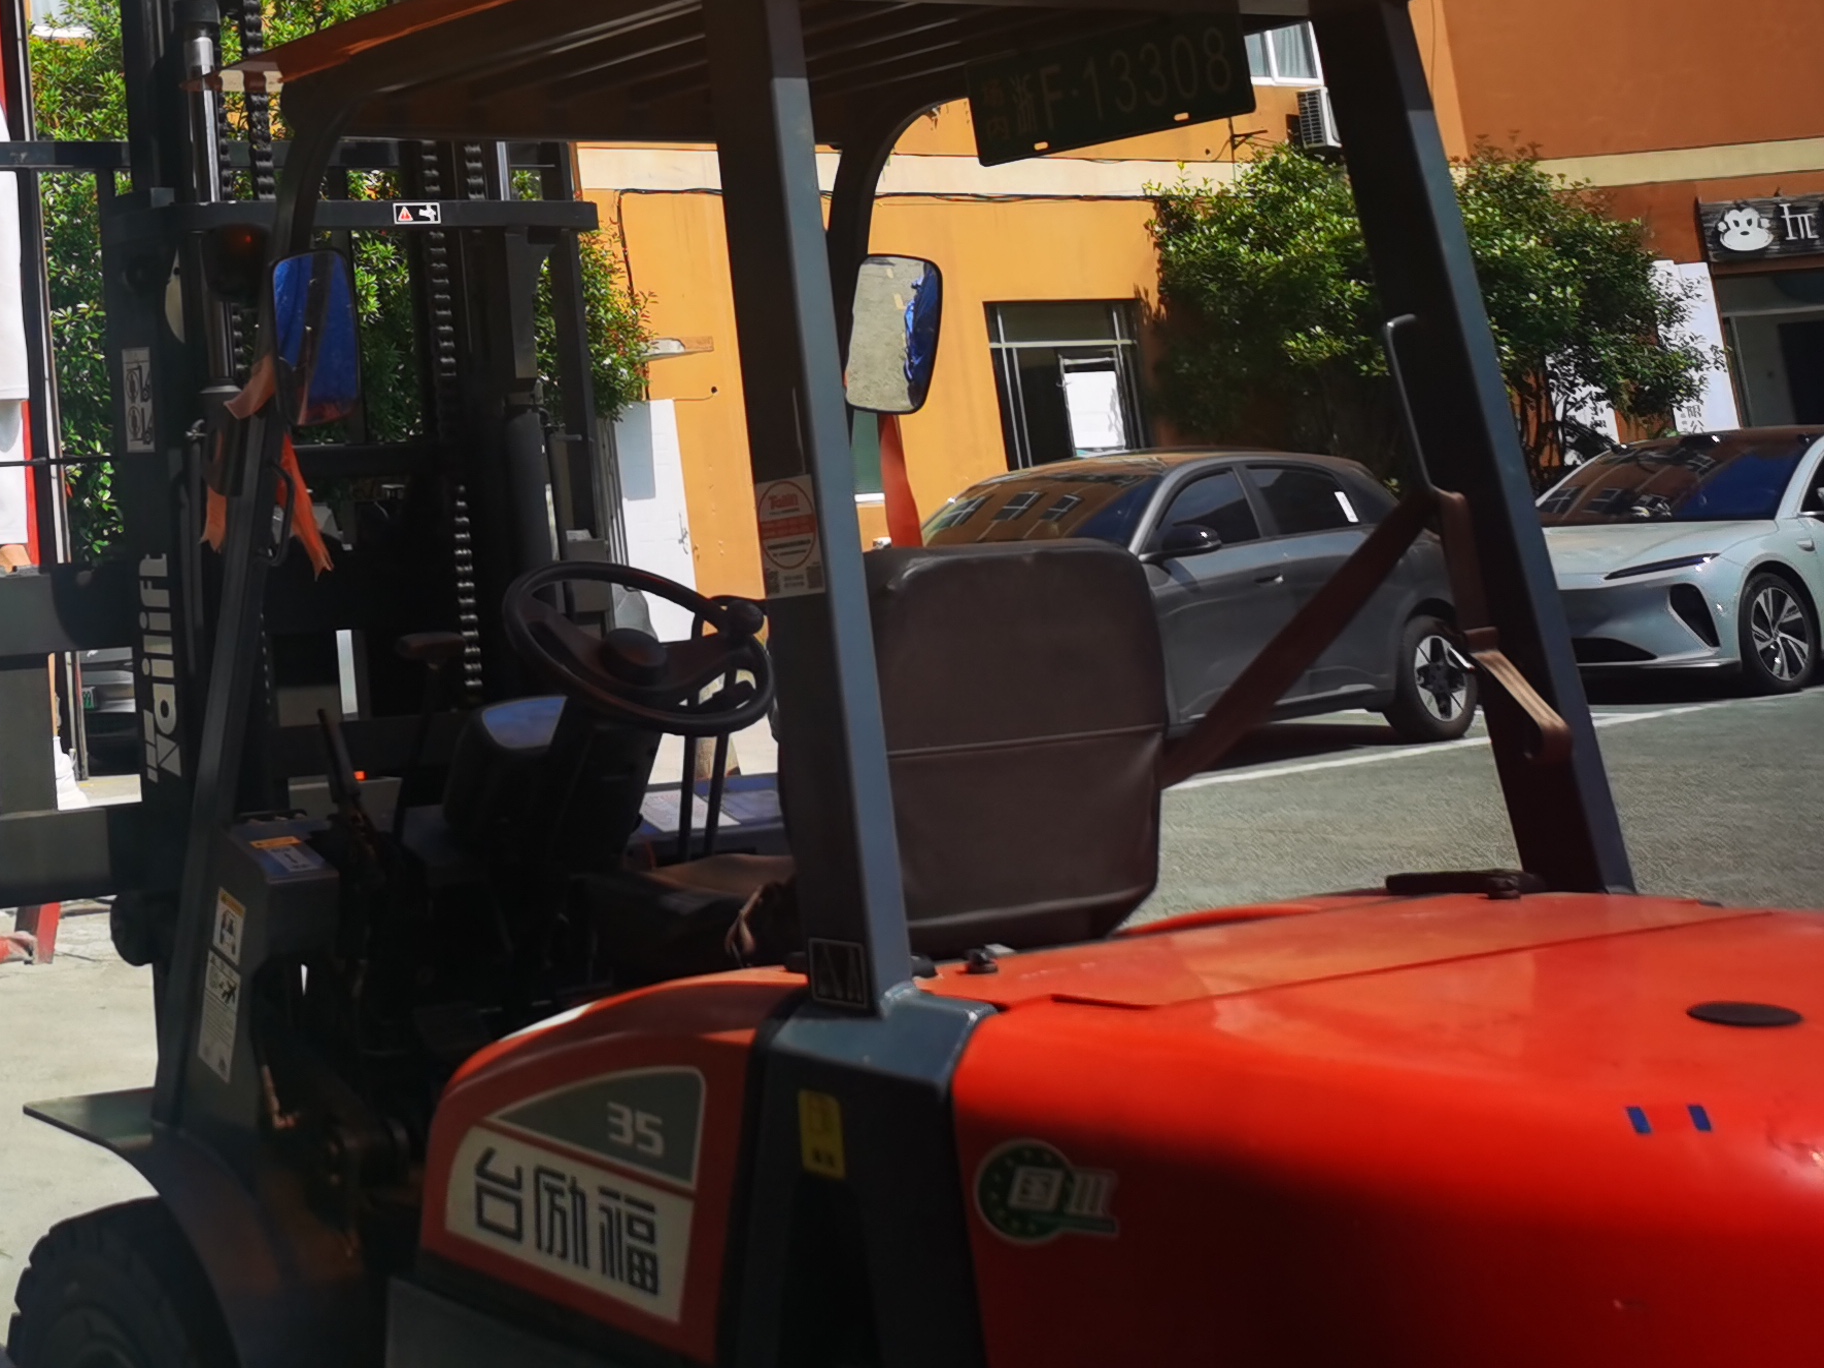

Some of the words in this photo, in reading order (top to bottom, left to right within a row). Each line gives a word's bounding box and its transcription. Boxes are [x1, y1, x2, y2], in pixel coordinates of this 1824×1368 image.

[139, 552, 181, 783] Tailift
[606, 1101, 664, 1158] 35
[474, 1146, 659, 1296] 台励福
